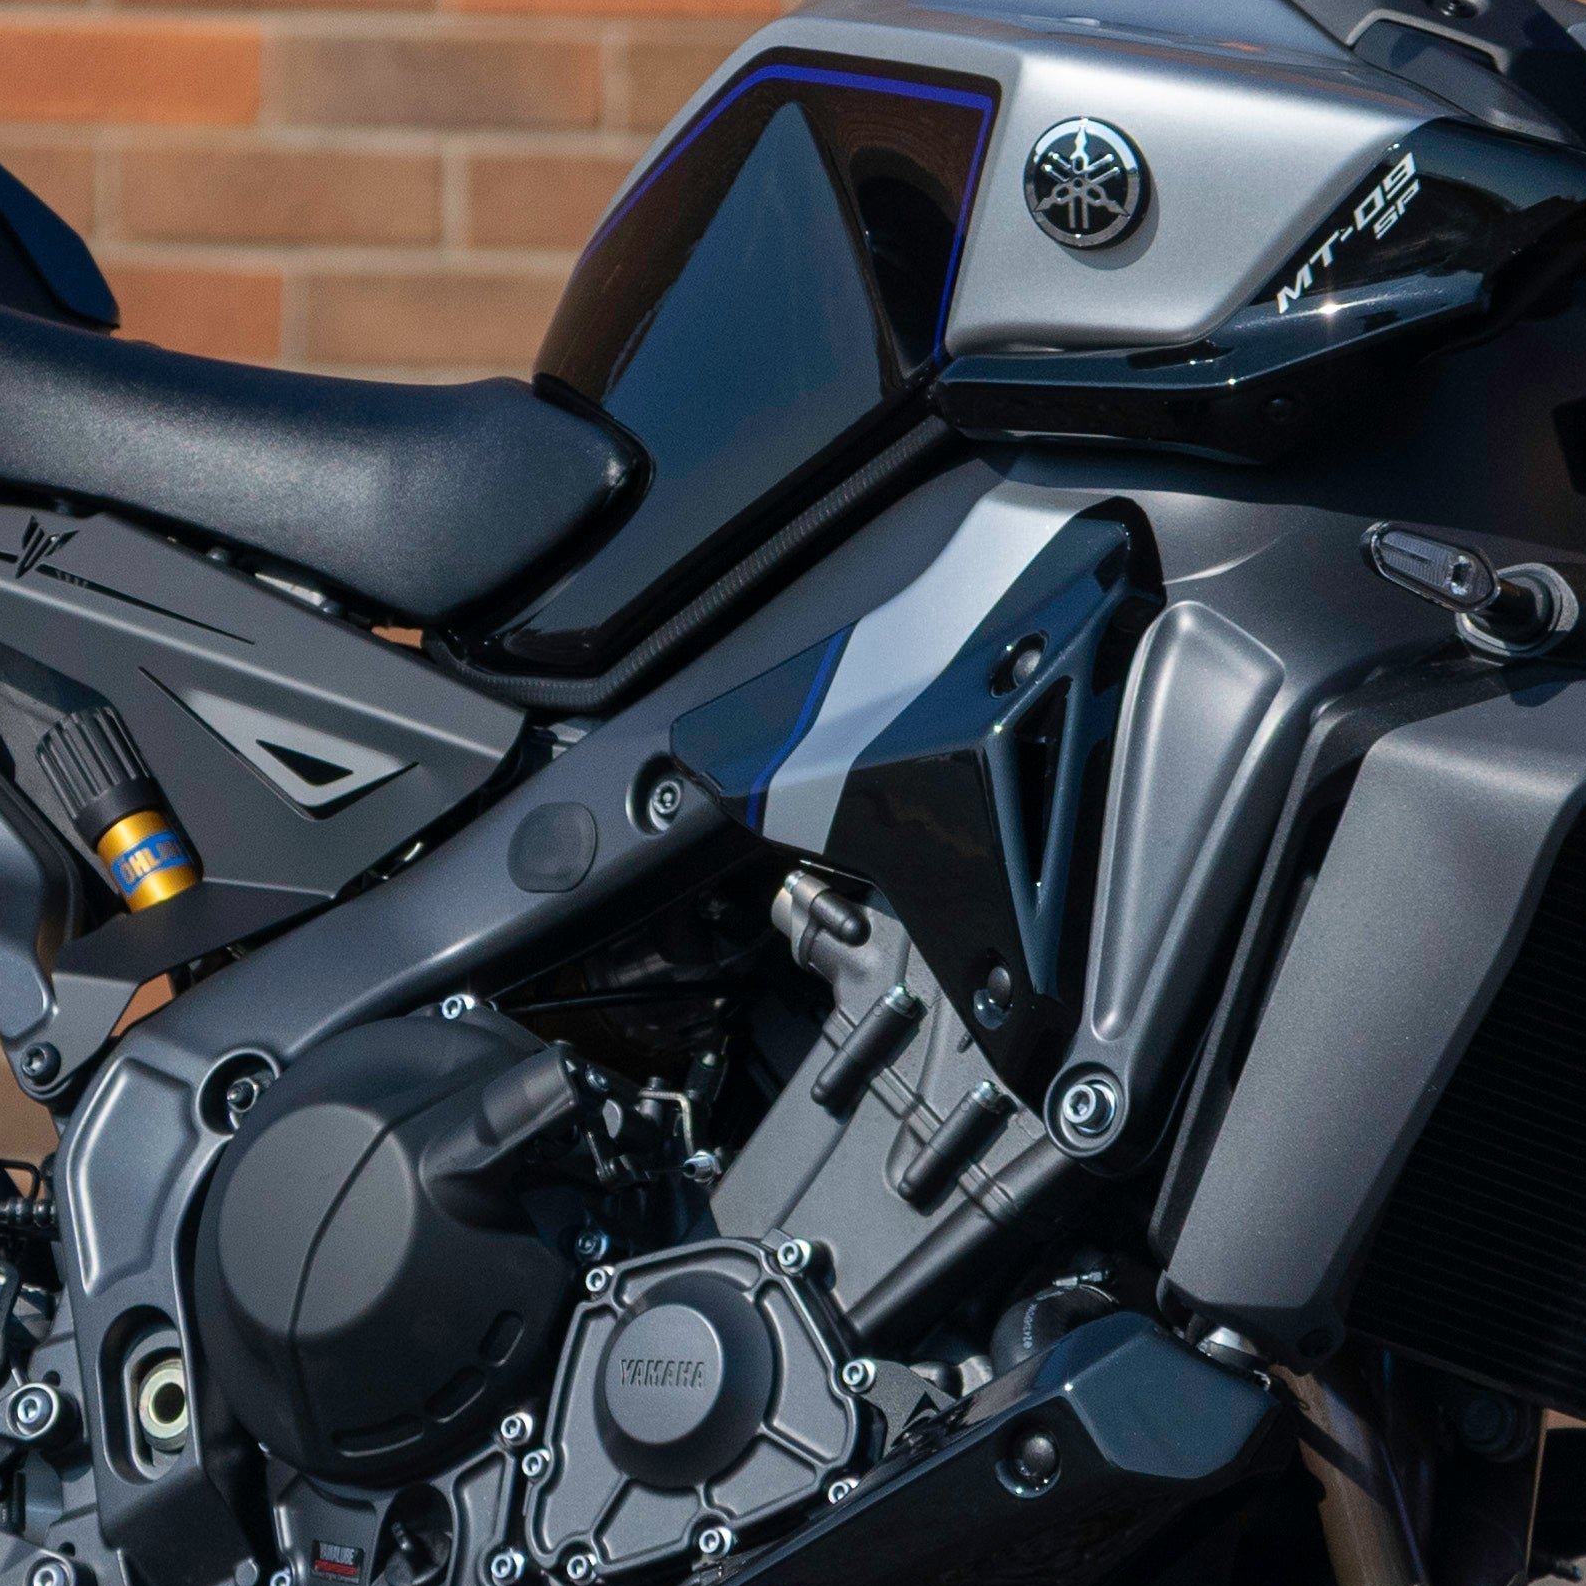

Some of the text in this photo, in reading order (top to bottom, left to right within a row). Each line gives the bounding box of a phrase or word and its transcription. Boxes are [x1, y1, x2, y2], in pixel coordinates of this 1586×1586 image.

[1276, 151, 1418, 314] MT-09
[1372, 178, 1422, 241] SP
[620, 1358, 705, 1389] YAMAHA
